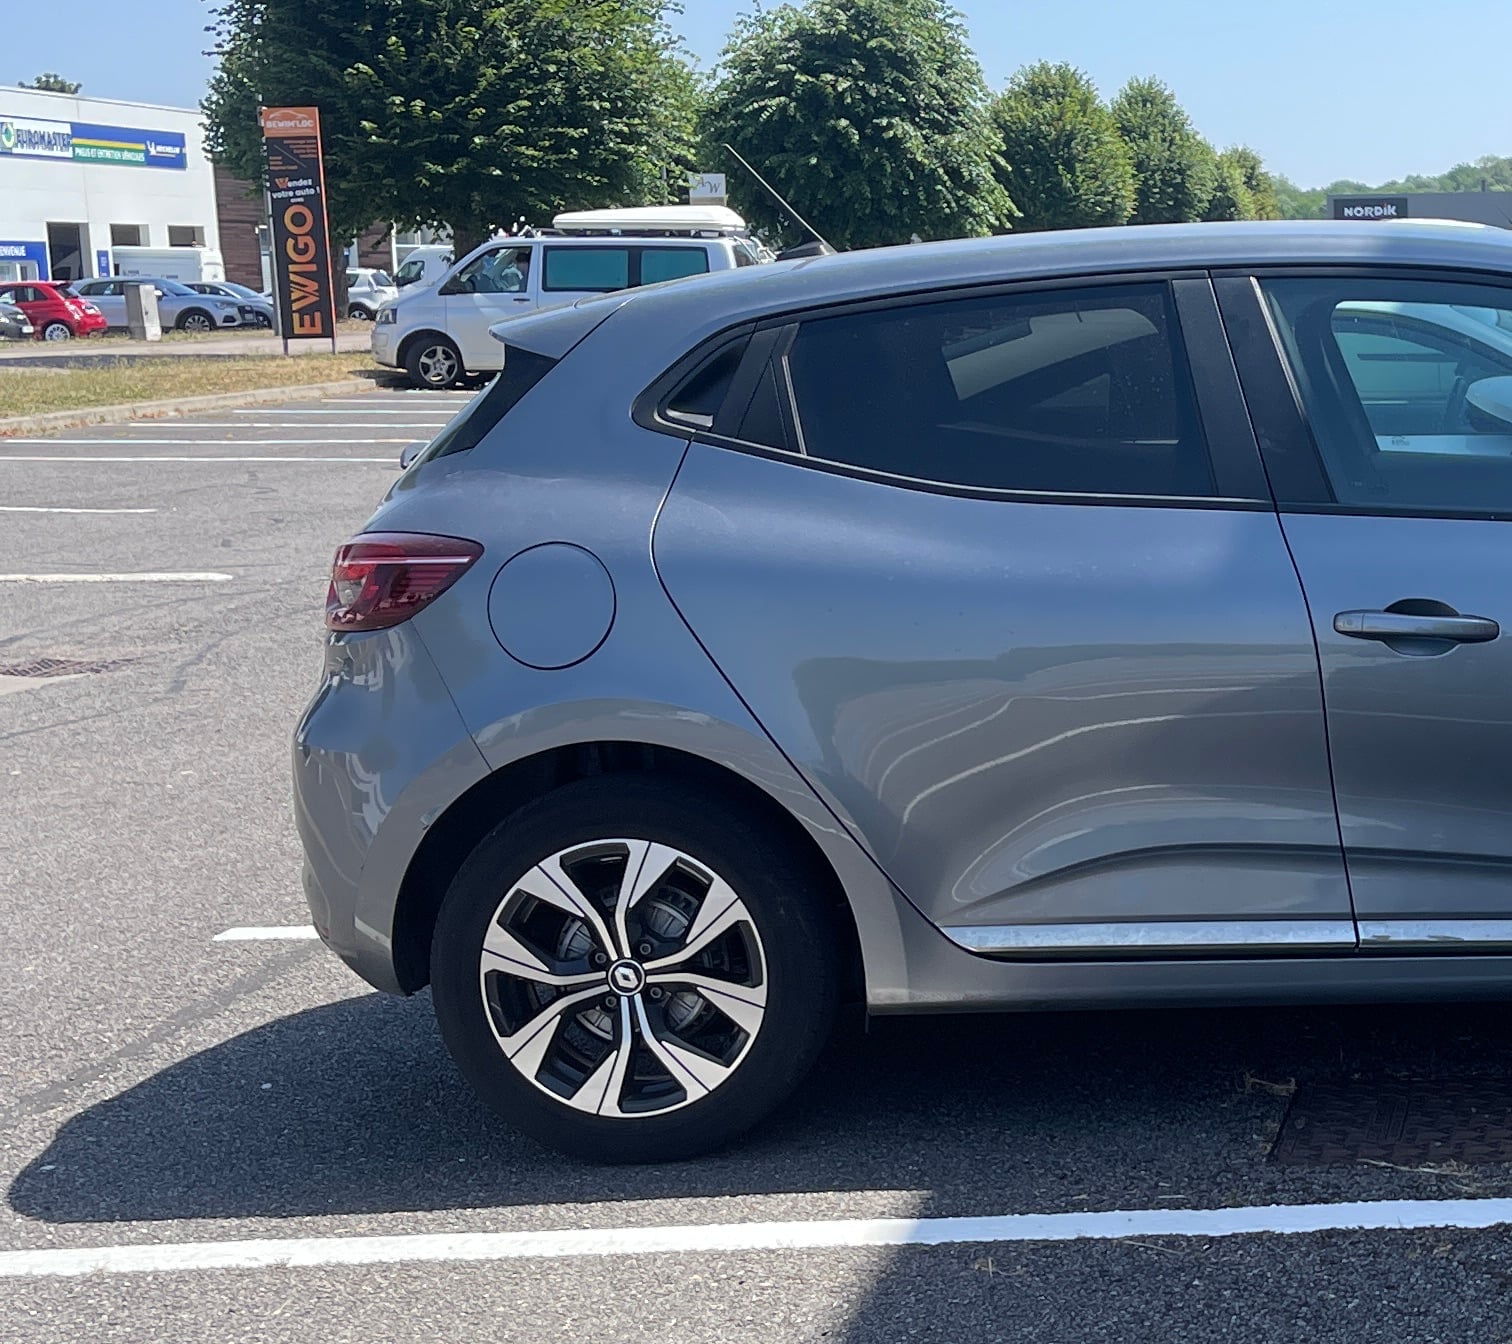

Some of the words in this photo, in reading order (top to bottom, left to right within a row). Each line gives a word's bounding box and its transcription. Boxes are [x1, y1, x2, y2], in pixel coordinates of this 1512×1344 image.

[15, 129, 71, 149] EUROMASTER
[272, 190, 294, 199] votre
[295, 188, 315, 196] auto
[284, 204, 322, 334] EWIGO
